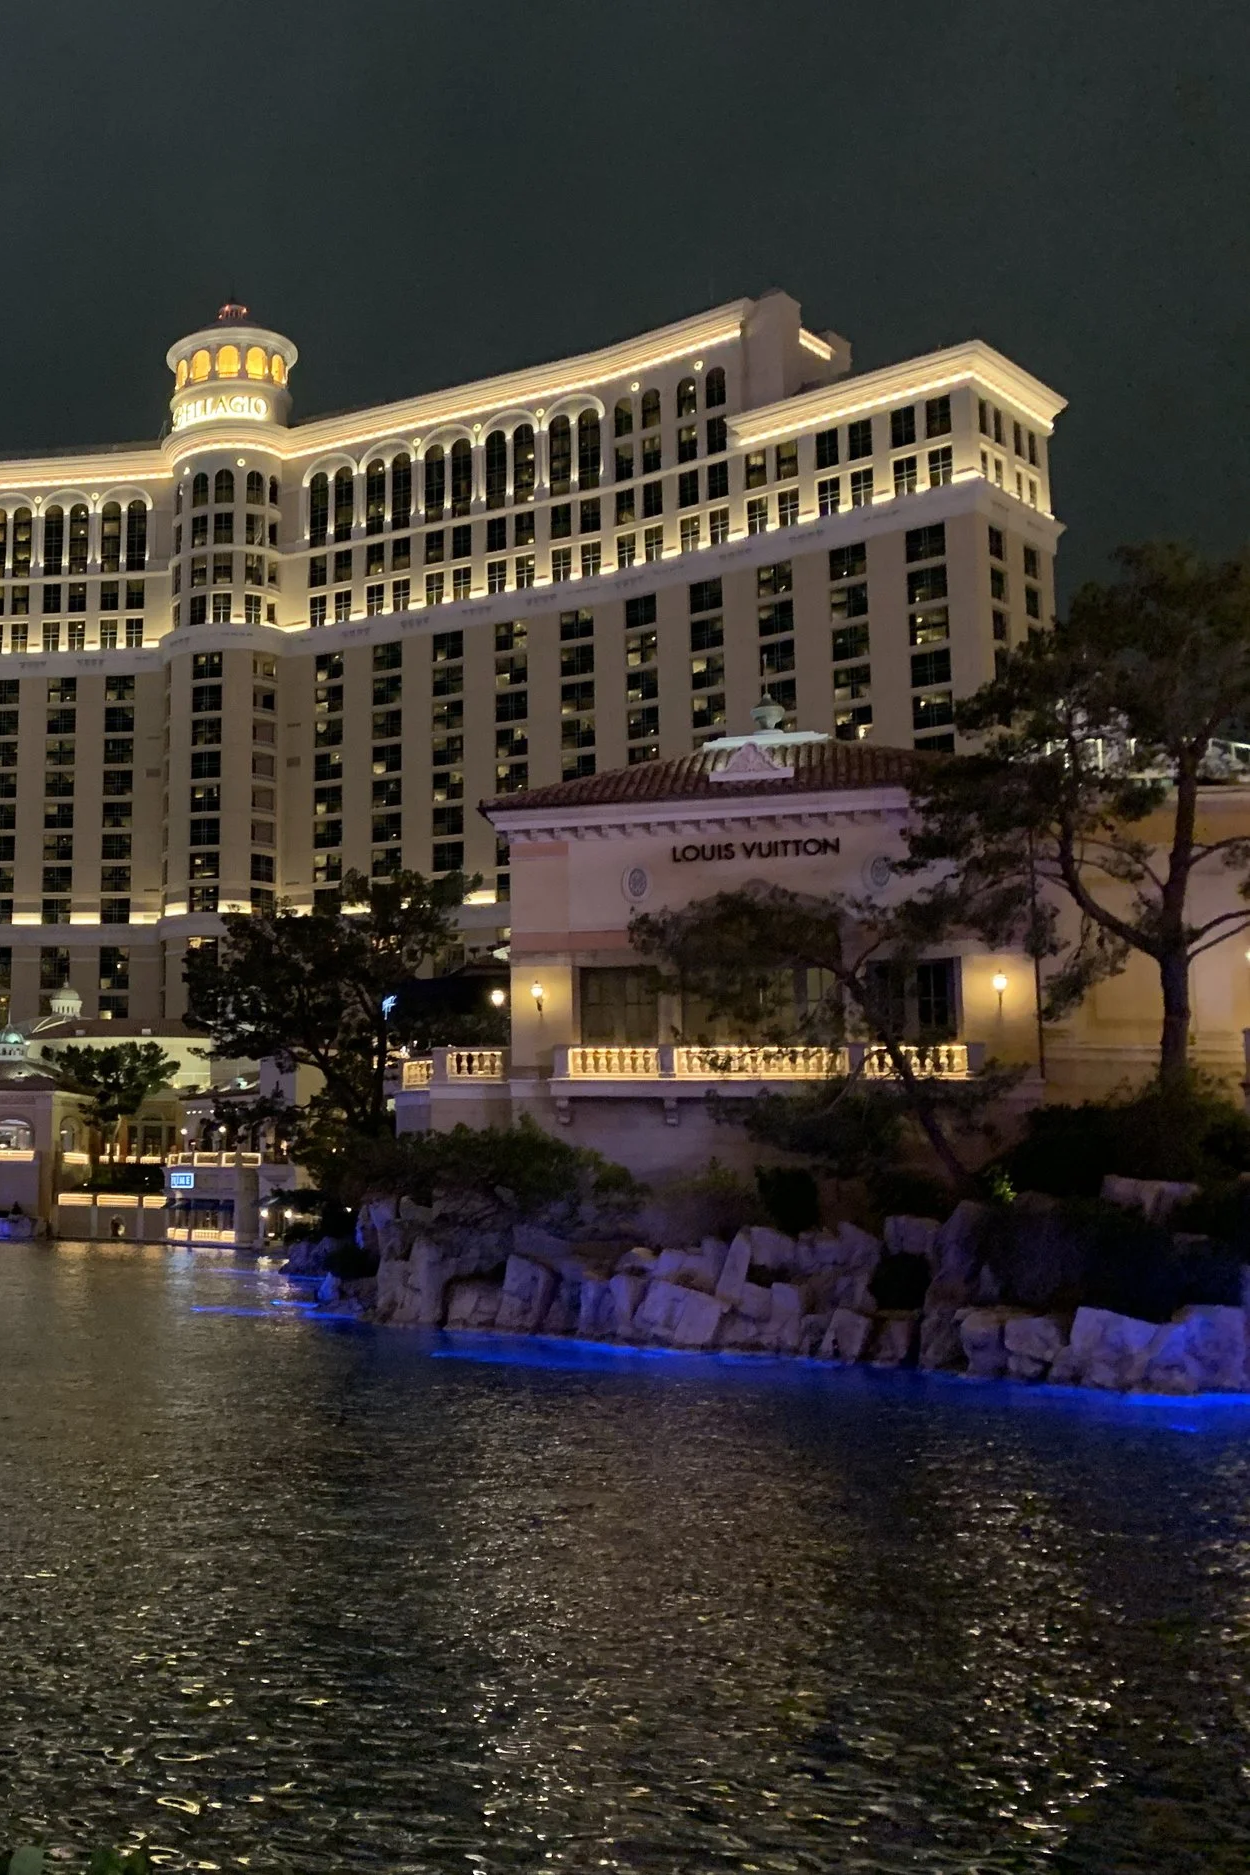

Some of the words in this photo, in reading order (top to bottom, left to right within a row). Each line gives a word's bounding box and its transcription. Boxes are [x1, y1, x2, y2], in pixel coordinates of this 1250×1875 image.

[172, 396, 268, 428] BELLAGIO
[671, 842, 736, 863] LOUIS
[741, 837, 841, 860] VUITTON
